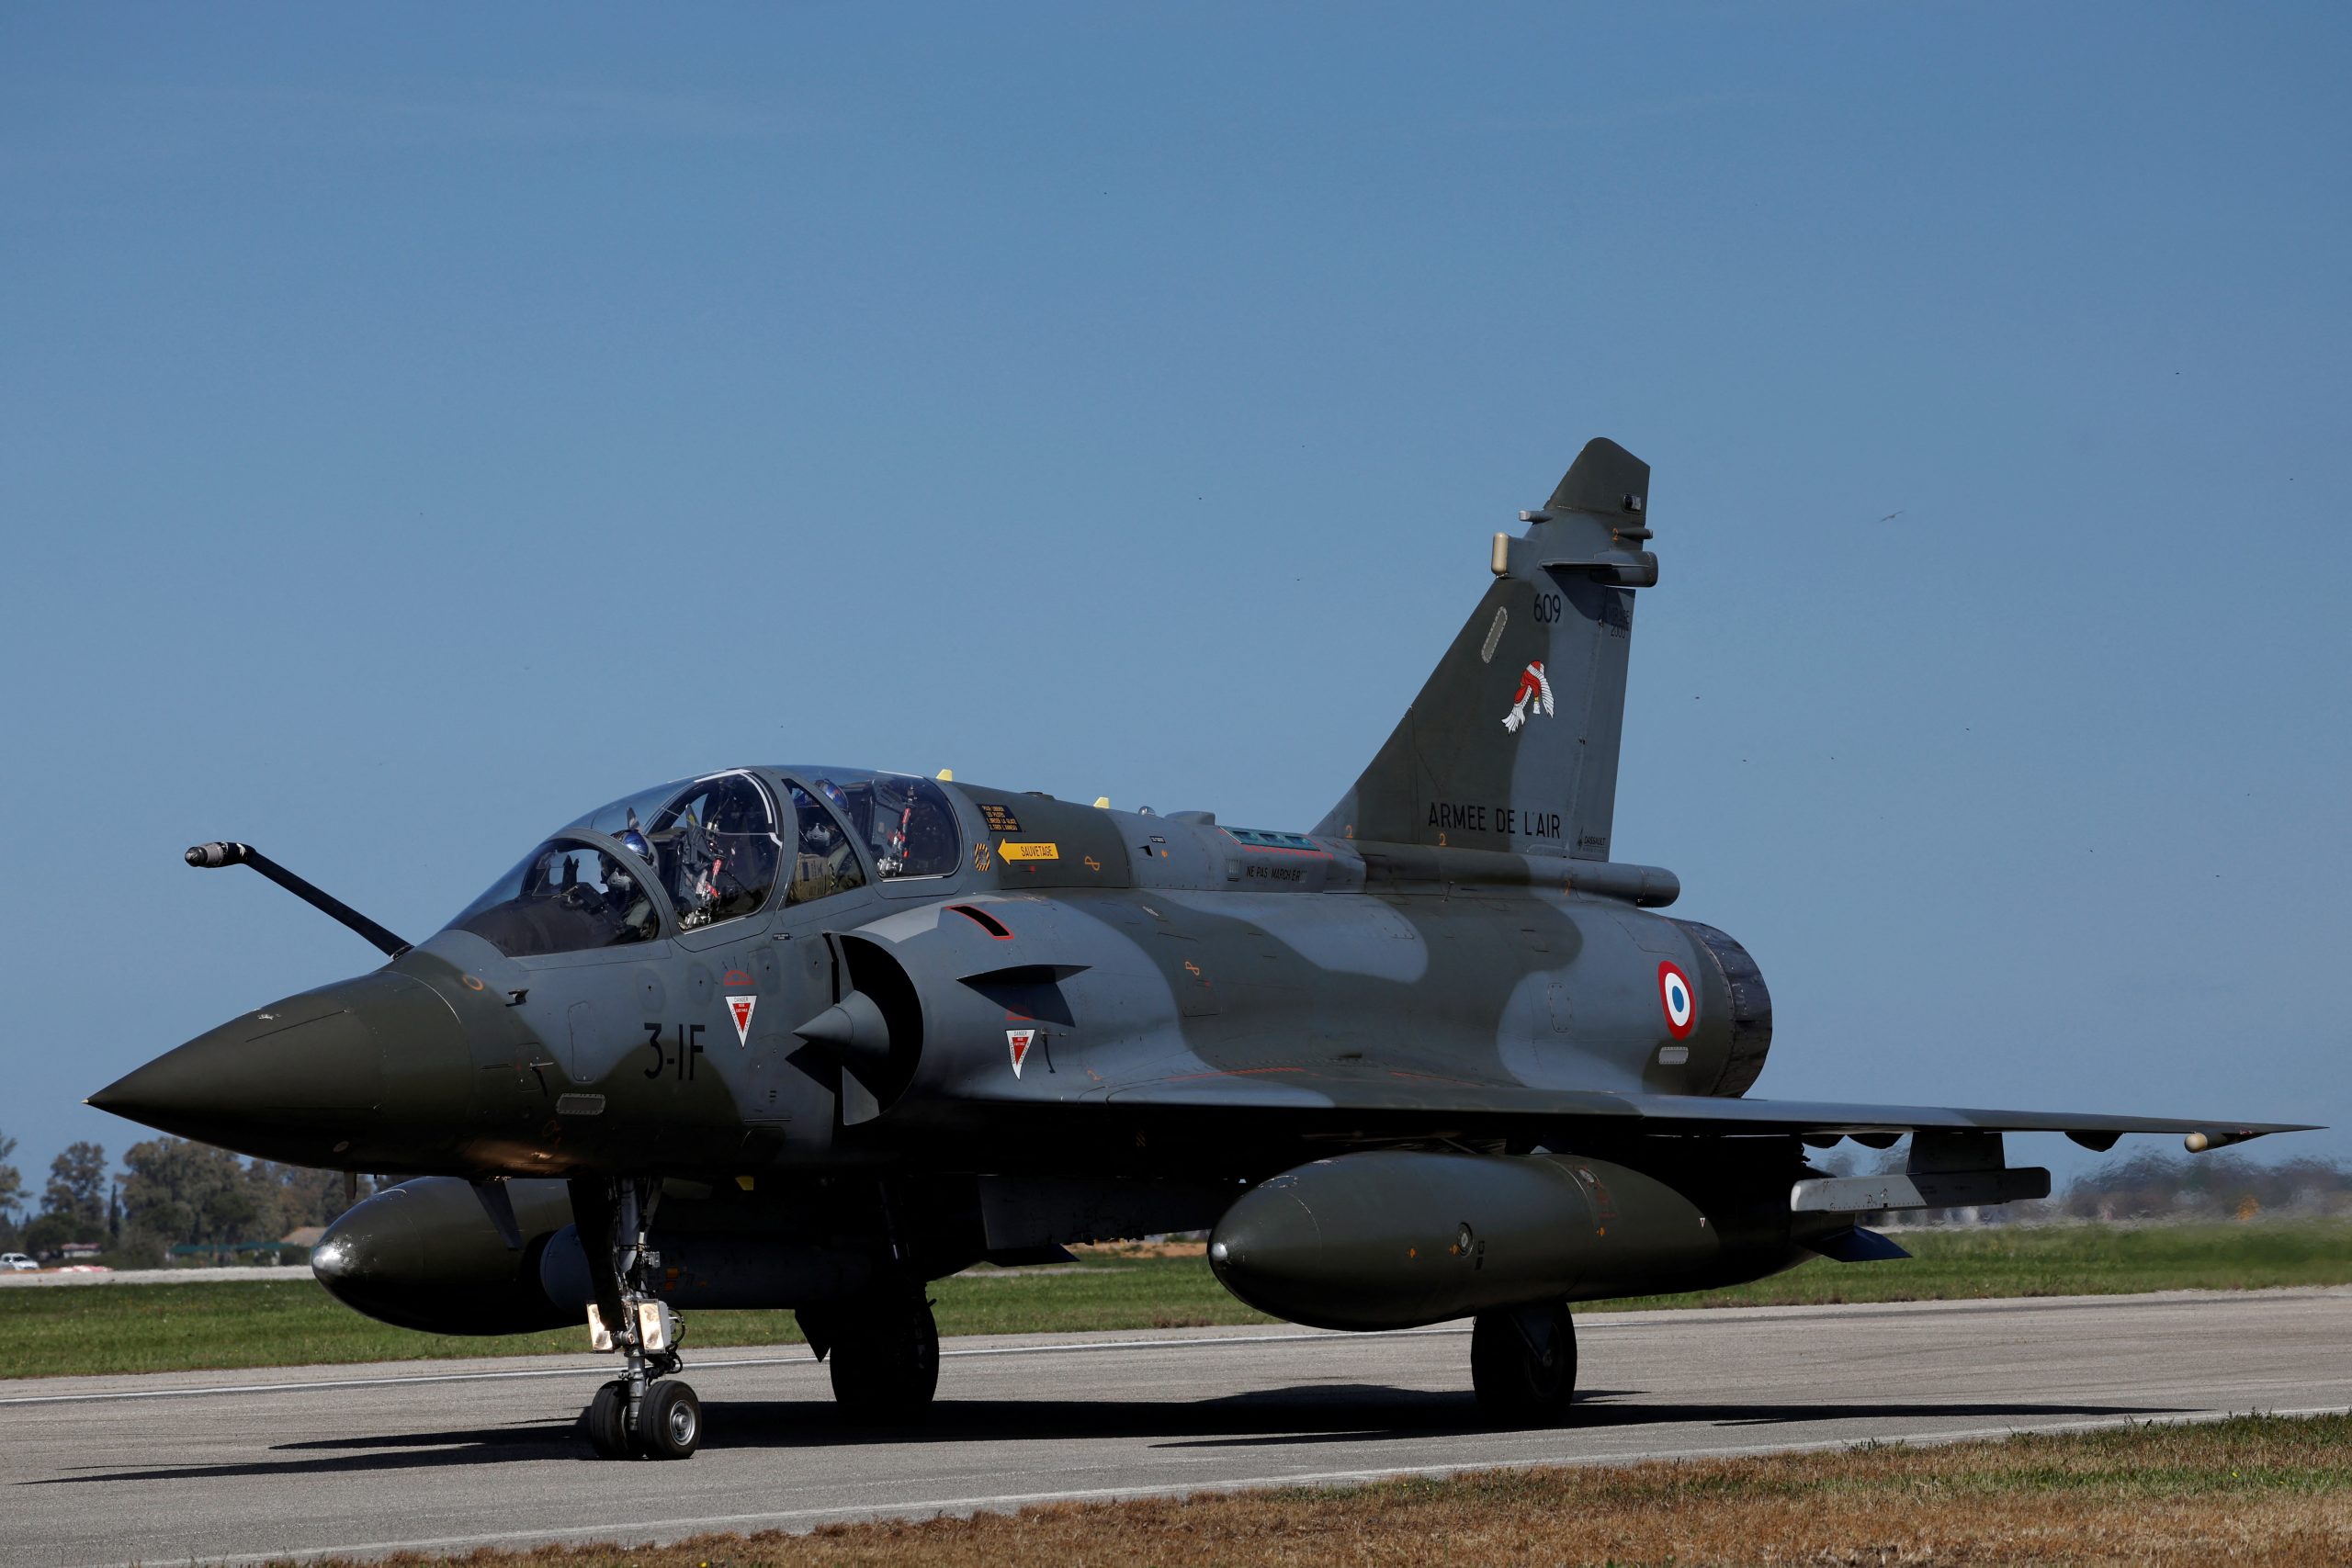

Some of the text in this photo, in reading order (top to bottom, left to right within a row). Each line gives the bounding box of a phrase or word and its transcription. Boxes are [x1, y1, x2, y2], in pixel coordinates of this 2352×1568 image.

[1534, 593, 1561, 624] 609
[1611, 624, 1626, 639] 2000
[1429, 802, 1561, 839] ARMEE DE L'AIR
[1439, 831, 1447, 846] 2
[1020, 846, 1053, 857] SAUVETAGE
[1246, 865, 1301, 882] NE PAS MARCHER
[644, 1021, 706, 1081] 3-IF
